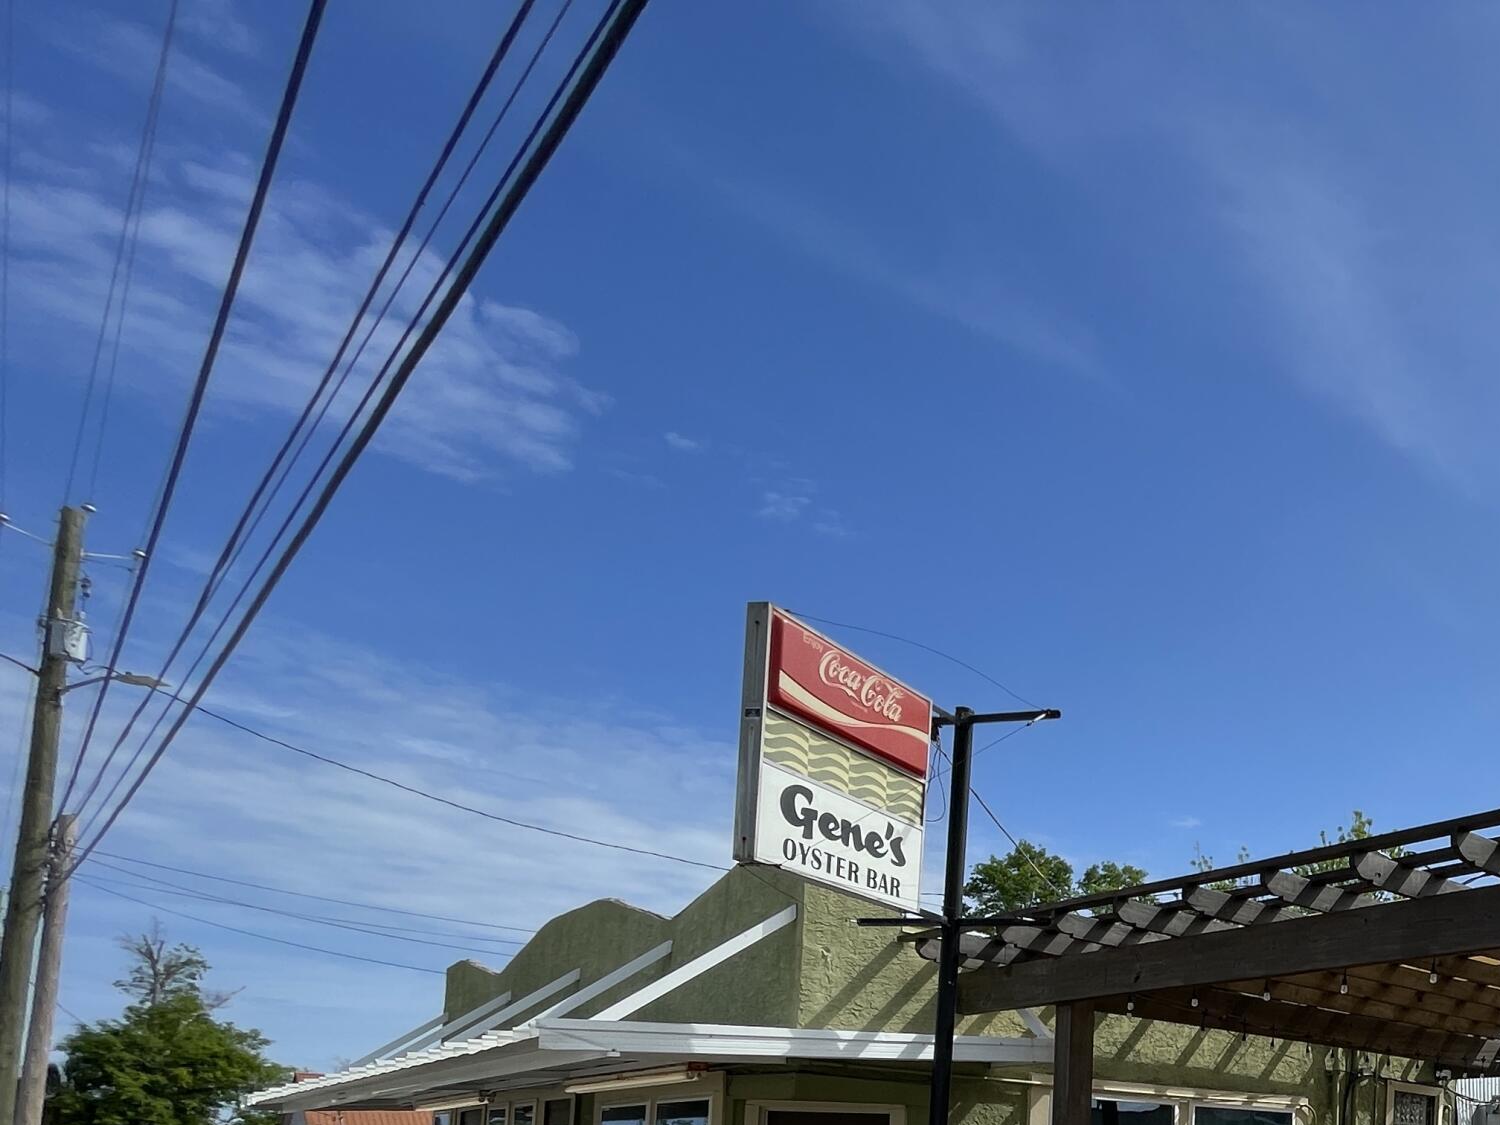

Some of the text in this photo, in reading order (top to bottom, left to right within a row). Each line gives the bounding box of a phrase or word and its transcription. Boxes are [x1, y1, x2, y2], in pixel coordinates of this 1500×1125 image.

[780, 784, 906, 867] Gene's
[782, 838, 901, 898] OYSTER BAR
